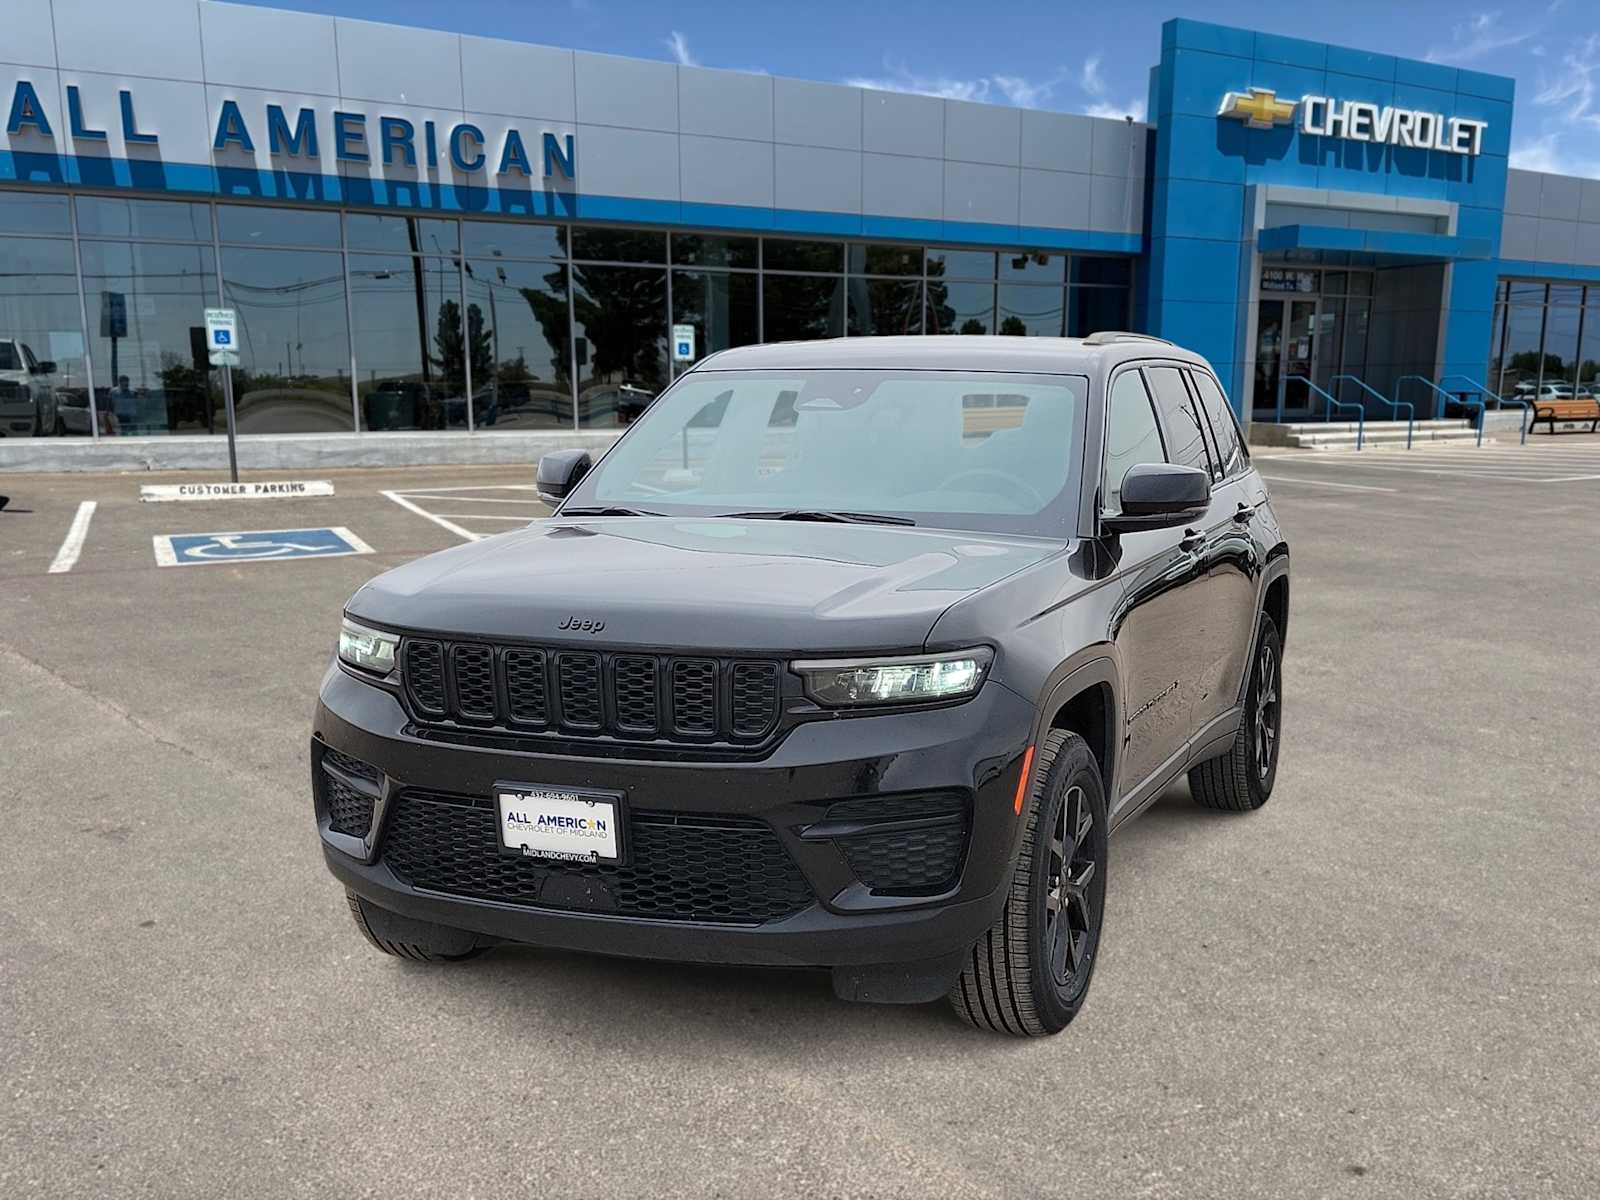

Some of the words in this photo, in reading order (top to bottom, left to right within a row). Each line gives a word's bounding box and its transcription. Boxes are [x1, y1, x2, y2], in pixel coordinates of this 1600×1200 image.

[6, 81, 158, 144] ALL
[213, 100, 575, 179] AMERICAN
[1300, 94, 1488, 155] CHEVROLET
[179, 485, 246, 496] CUSTOMER
[254, 483, 306, 494] PARKING
[558, 615, 605, 634] Jeep
[507, 812, 531, 823] ALL
[507, 823, 555, 834] CHEVROLET
[569, 829, 608, 839] MIDLAND
[522, 848, 597, 863] MIDLANDCHEVY.COM
